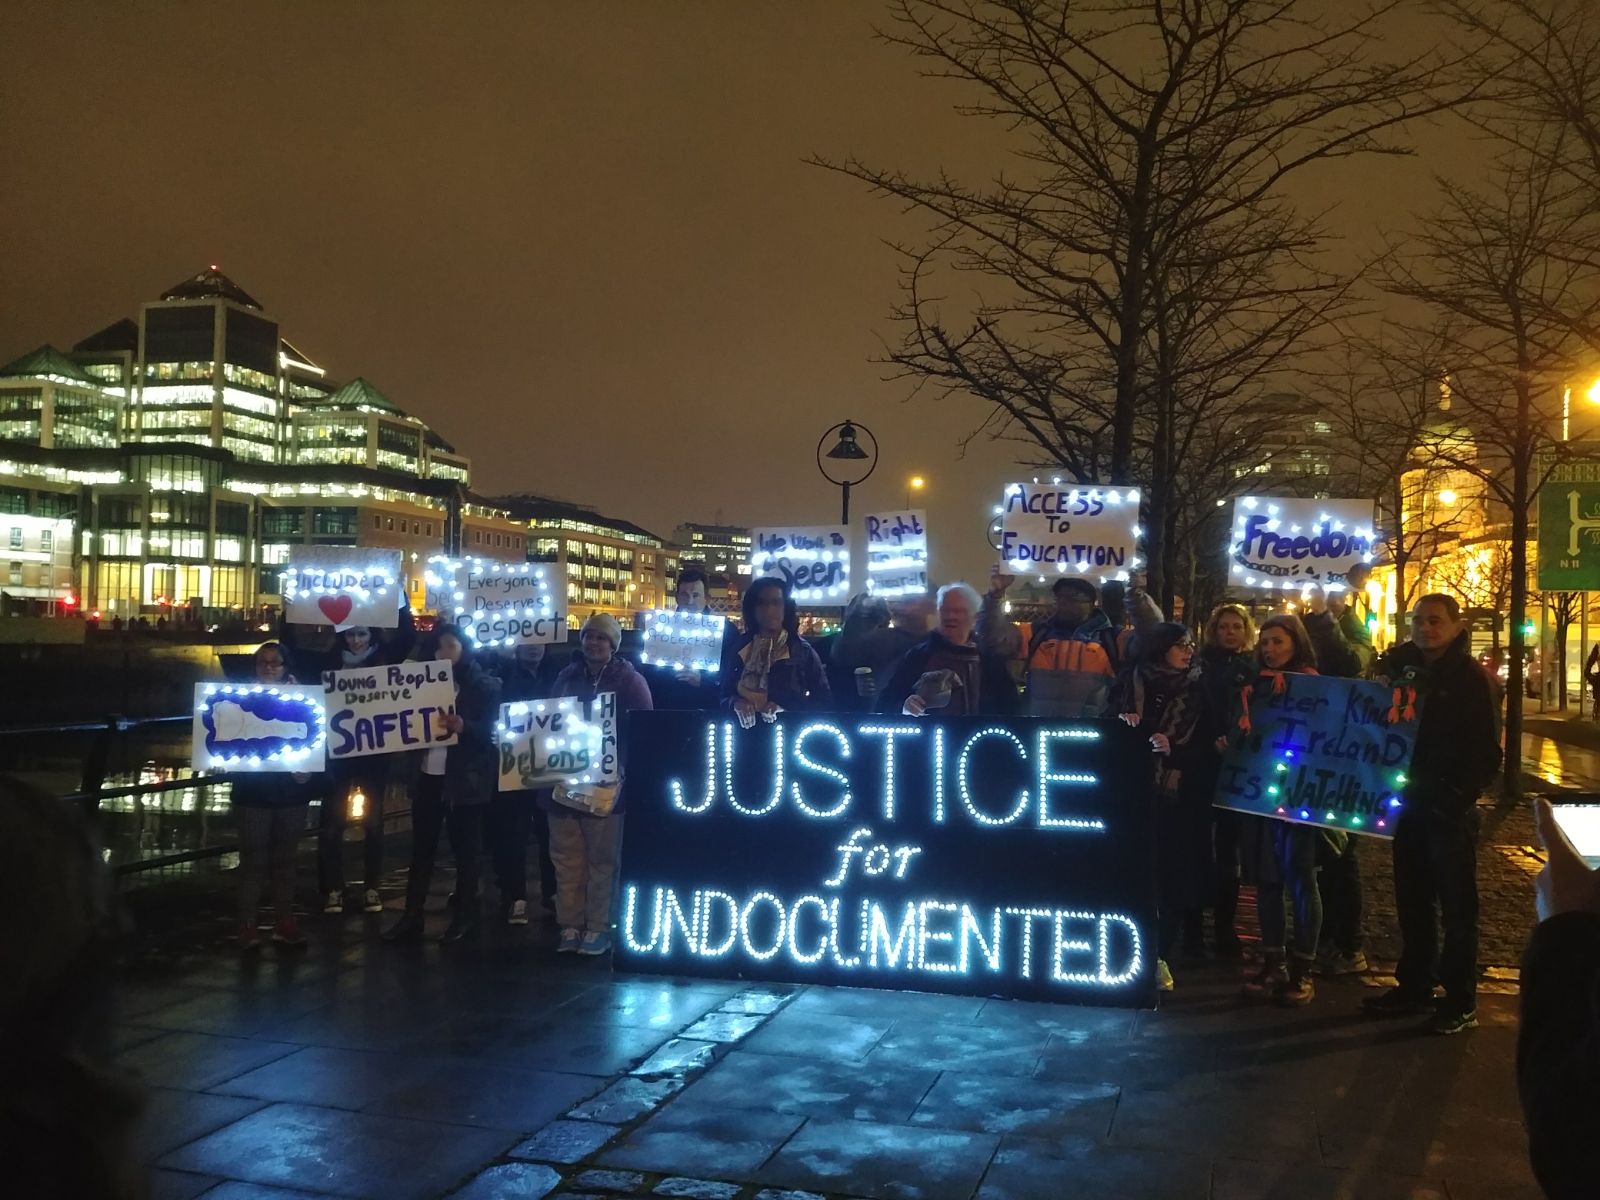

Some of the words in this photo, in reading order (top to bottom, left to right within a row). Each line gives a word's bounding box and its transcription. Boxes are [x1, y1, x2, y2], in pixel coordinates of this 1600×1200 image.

[1007, 484, 1104, 517] ACCESS
[866, 515, 923, 545] Right
[1243, 513, 1368, 560] Freedom
[1001, 532, 1125, 567] EDUCATION
[467, 572, 540, 594] Everyone
[475, 595, 545, 611] Deserves
[456, 611, 565, 645] Respect
[504, 704, 563, 733] Live
[671, 721, 1104, 829] JUSTICE
[824, 827, 922, 887] for
[623, 885, 1143, 986] UNDOCUMENTED
